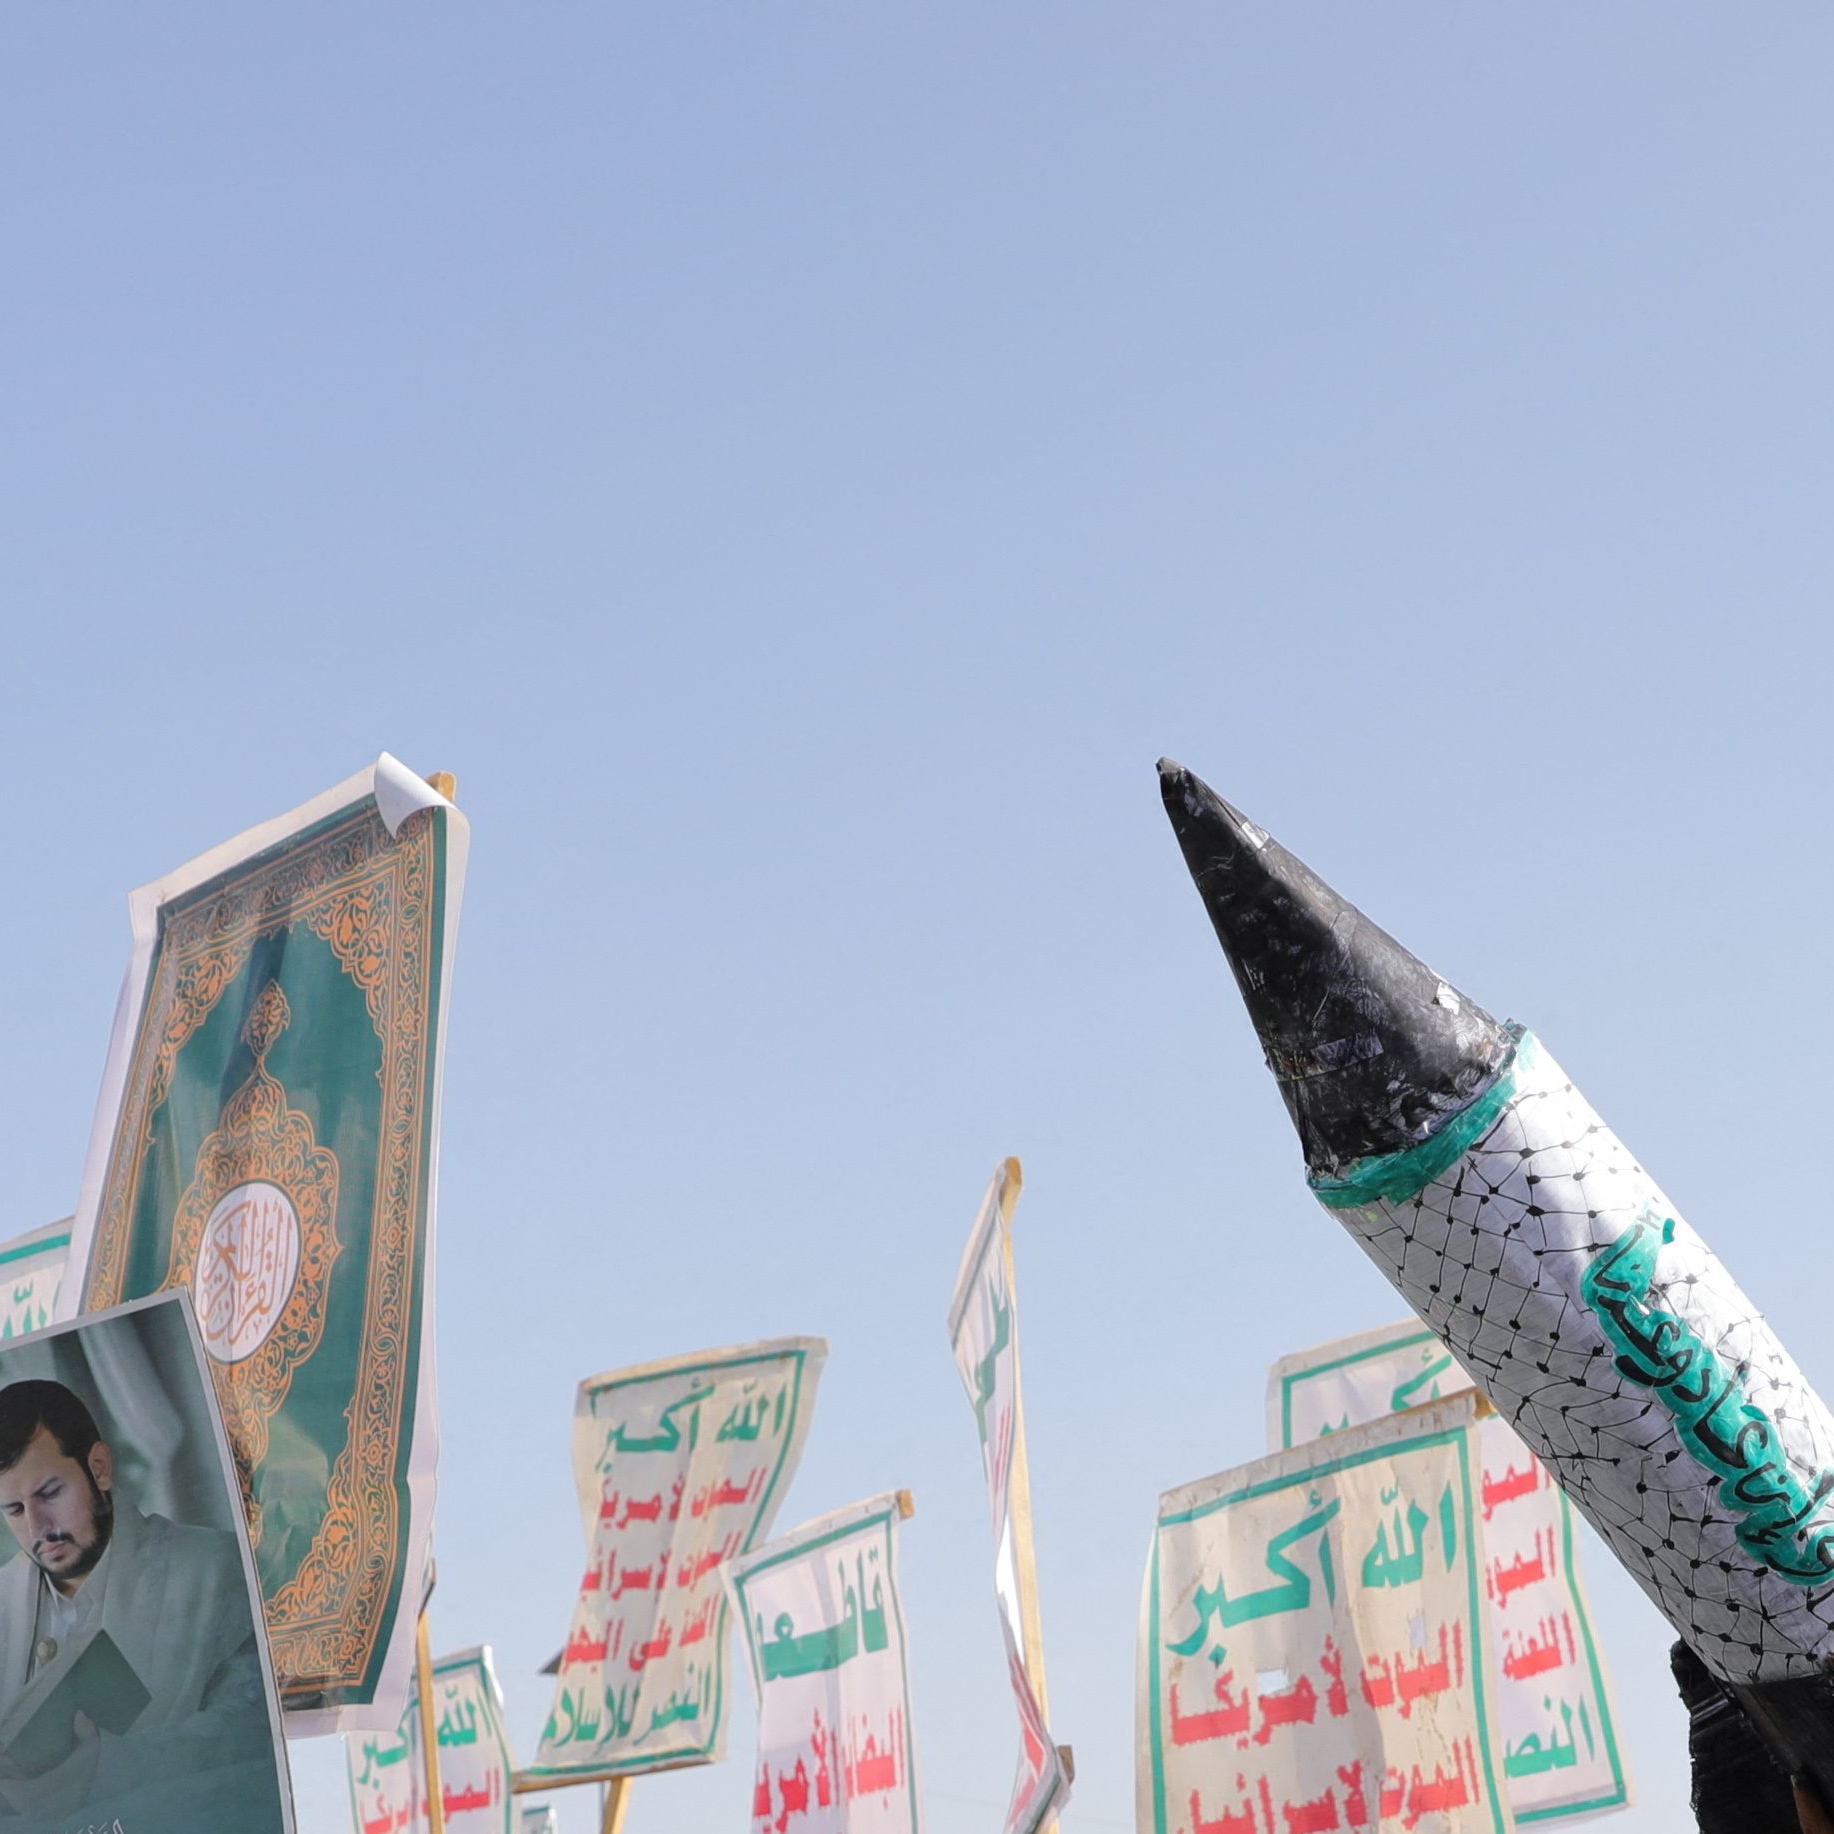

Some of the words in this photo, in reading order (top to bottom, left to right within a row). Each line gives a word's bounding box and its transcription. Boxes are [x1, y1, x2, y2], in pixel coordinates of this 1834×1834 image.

[595, 1376, 716, 1473] أكبر
[715, 1381, 787, 1443] الله
[692, 1466, 767, 1521] الموت
[1361, 1478, 1459, 1590] الله
[1166, 1486, 1342, 1670] أكبر
[1485, 1522, 1557, 1610] المو
[1169, 1630, 1349, 1751] لأمريكا
[1360, 1616, 1466, 1720] الموت
[1501, 1609, 1578, 1681] اللعنة
[356, 1698, 421, 1791] كبر
[437, 1686, 493, 1747] الله
[631, 1660, 714, 1748] النصر
[1504, 1690, 1597, 1779] النص
[1379, 1735, 1480, 1831] الموت
